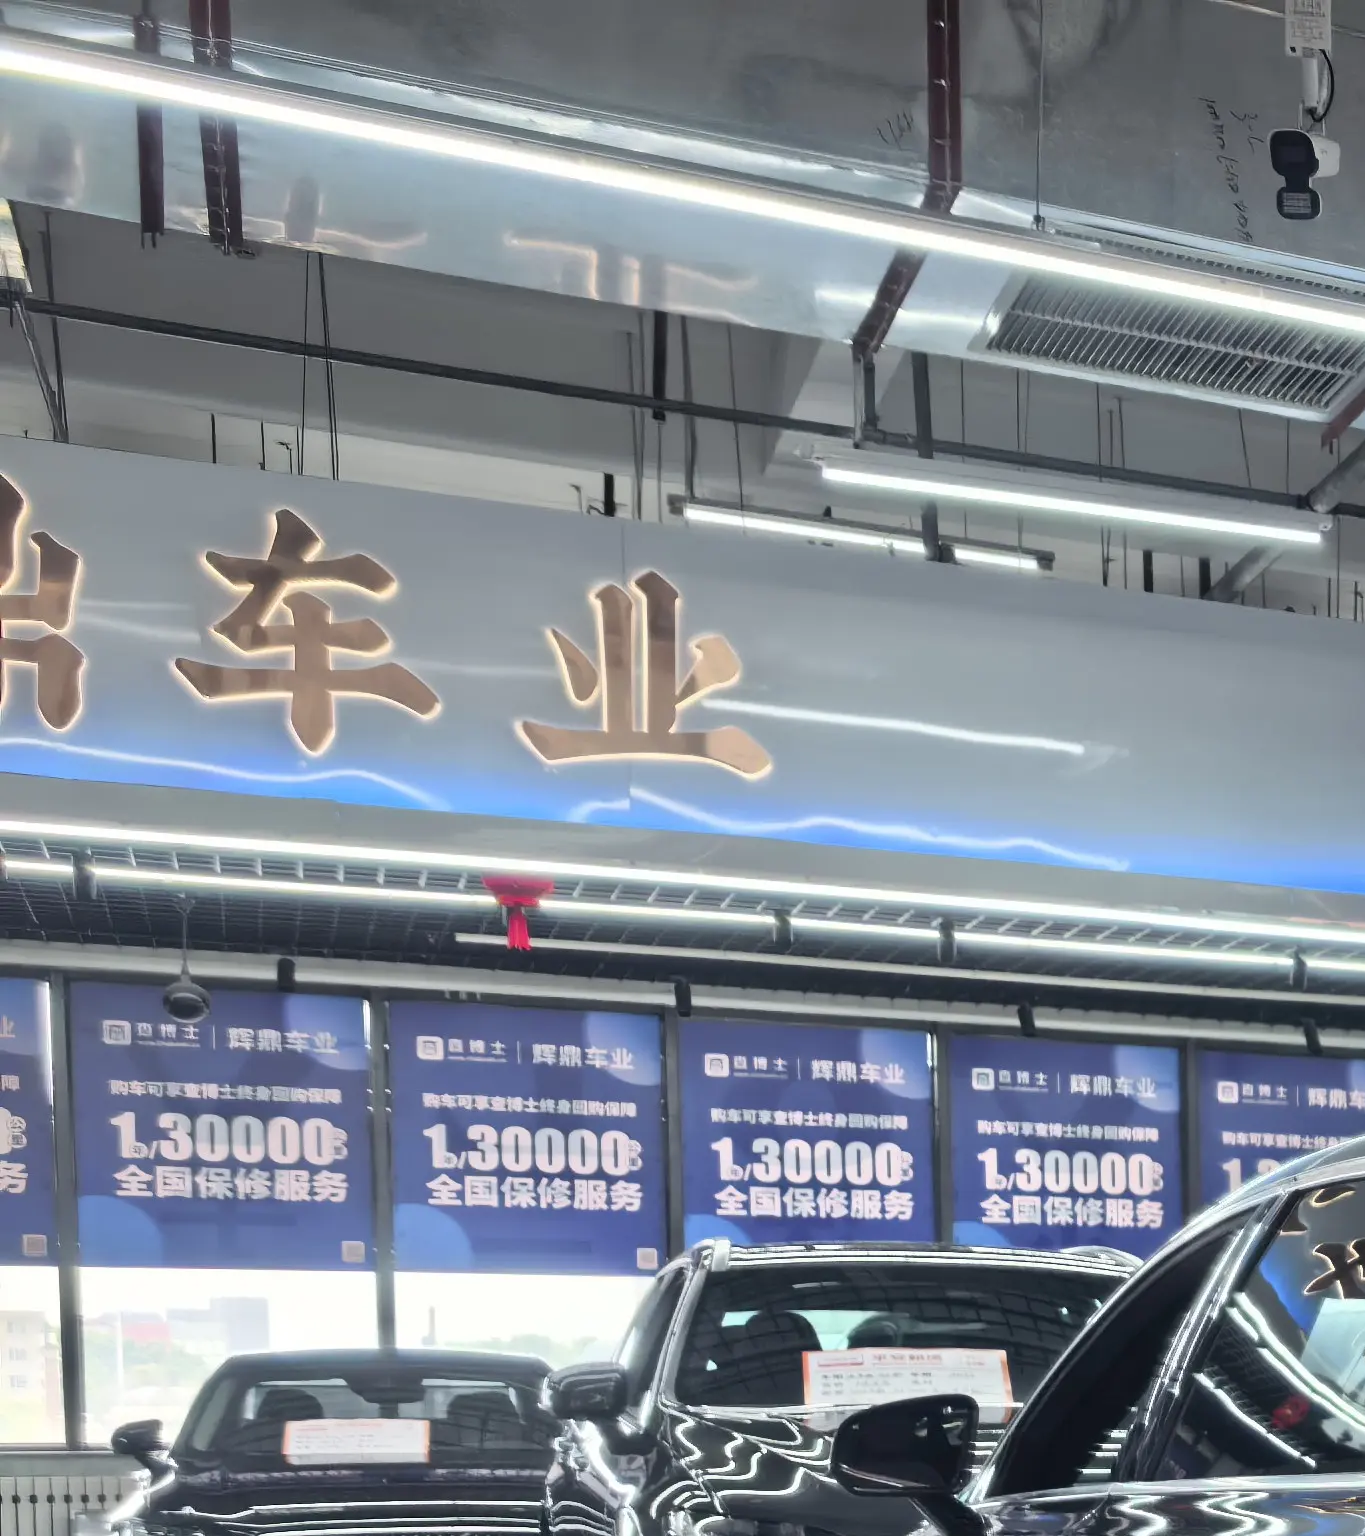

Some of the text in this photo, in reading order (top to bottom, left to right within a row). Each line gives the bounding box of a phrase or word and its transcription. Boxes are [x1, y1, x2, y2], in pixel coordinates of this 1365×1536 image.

[226, 1026, 339, 1054] 辉鼎车业
[532, 1043, 634, 1070] 辉鼎车业
[810, 1058, 906, 1084] 辉鼎车业
[1070, 1073, 1156, 1098] 辉鼎车业
[113, 1164, 349, 1203] 全国保修服务
[425, 1173, 643, 1212] 全国保修服务
[714, 1184, 914, 1221] 全国保修服务
[980, 1193, 1164, 1229] 全国保修服务
